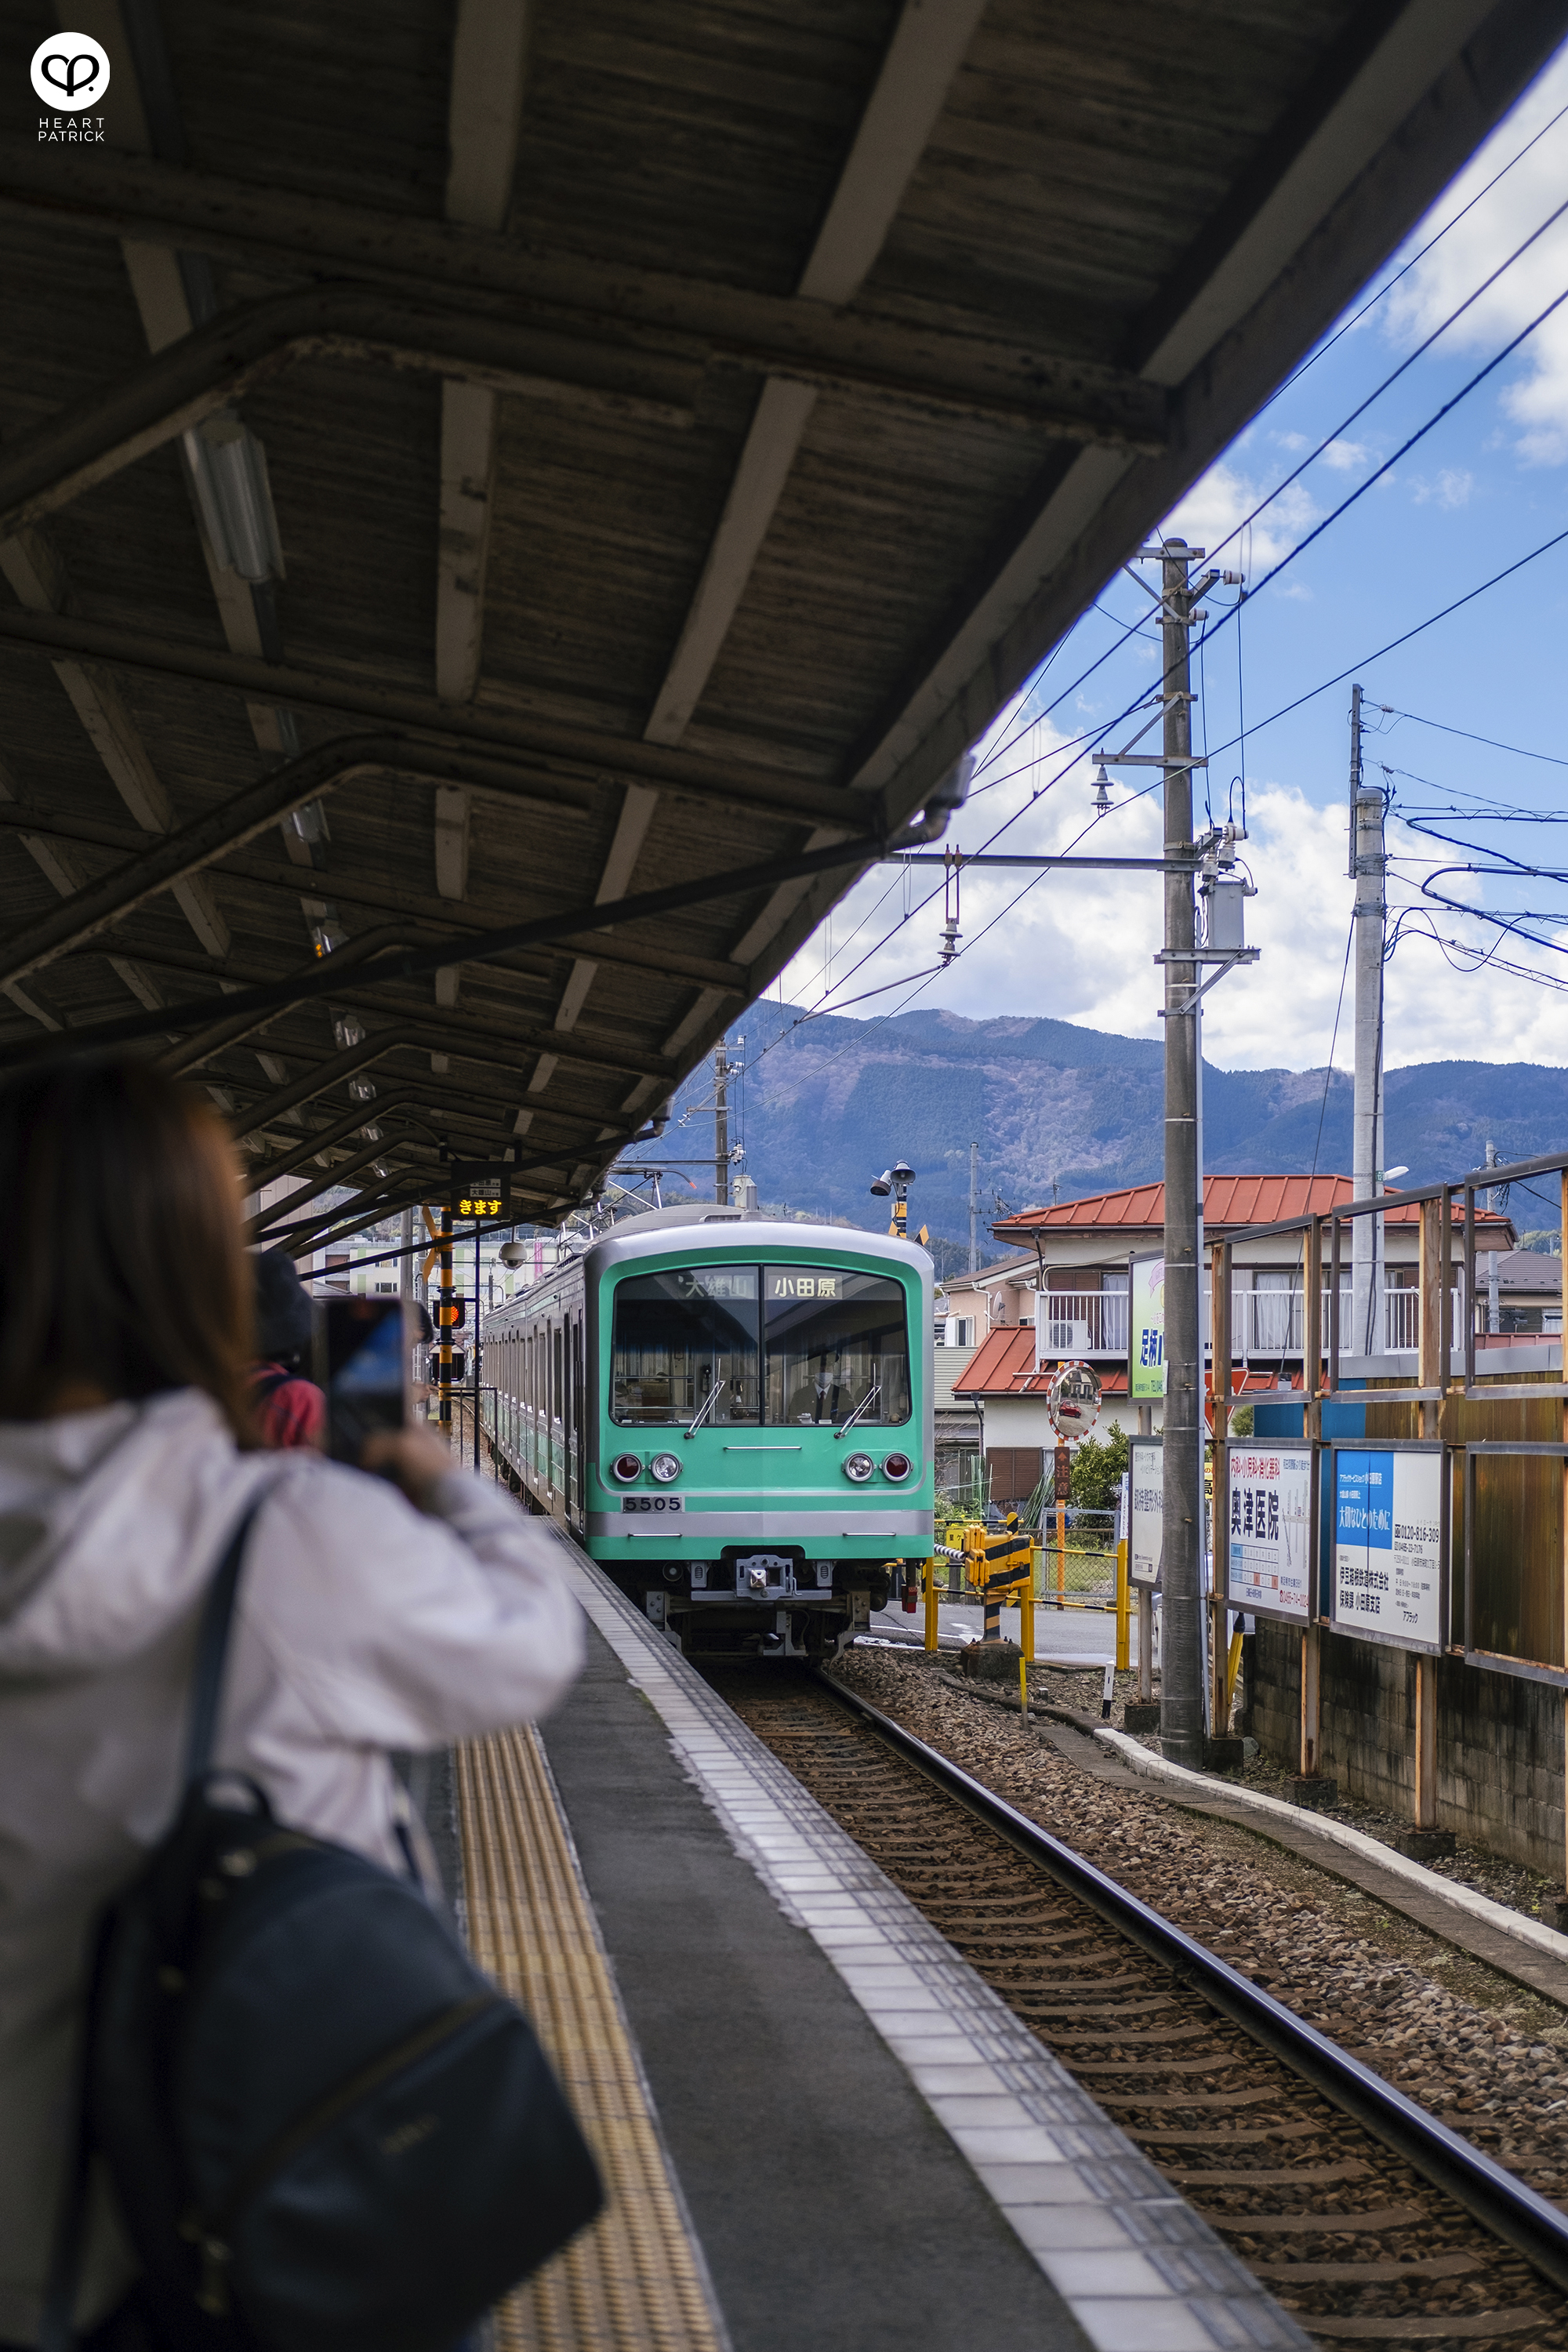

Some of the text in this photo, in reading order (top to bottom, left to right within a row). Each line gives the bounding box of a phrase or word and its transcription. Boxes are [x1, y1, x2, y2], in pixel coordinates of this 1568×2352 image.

[459, 1200, 502, 1215] きます
[685, 1277, 747, 1298] 大雄山
[775, 1277, 837, 1298] 小田原
[1057, 1465, 1069, 1495] 注意
[626, 1497, 681, 1511] 5505
[1231, 1486, 1279, 1541] 奥津医院
[1339, 1506, 1391, 1530] 大切なひとのために
[1401, 1525, 1439, 1543] 0120-816-309
[1340, 1566, 1388, 1592] 伊豆箱根鉄道株式会社
[1340, 1590, 1381, 1614] 保険課 小田原支店
[1403, 1610, 1418, 1624] アフラック
